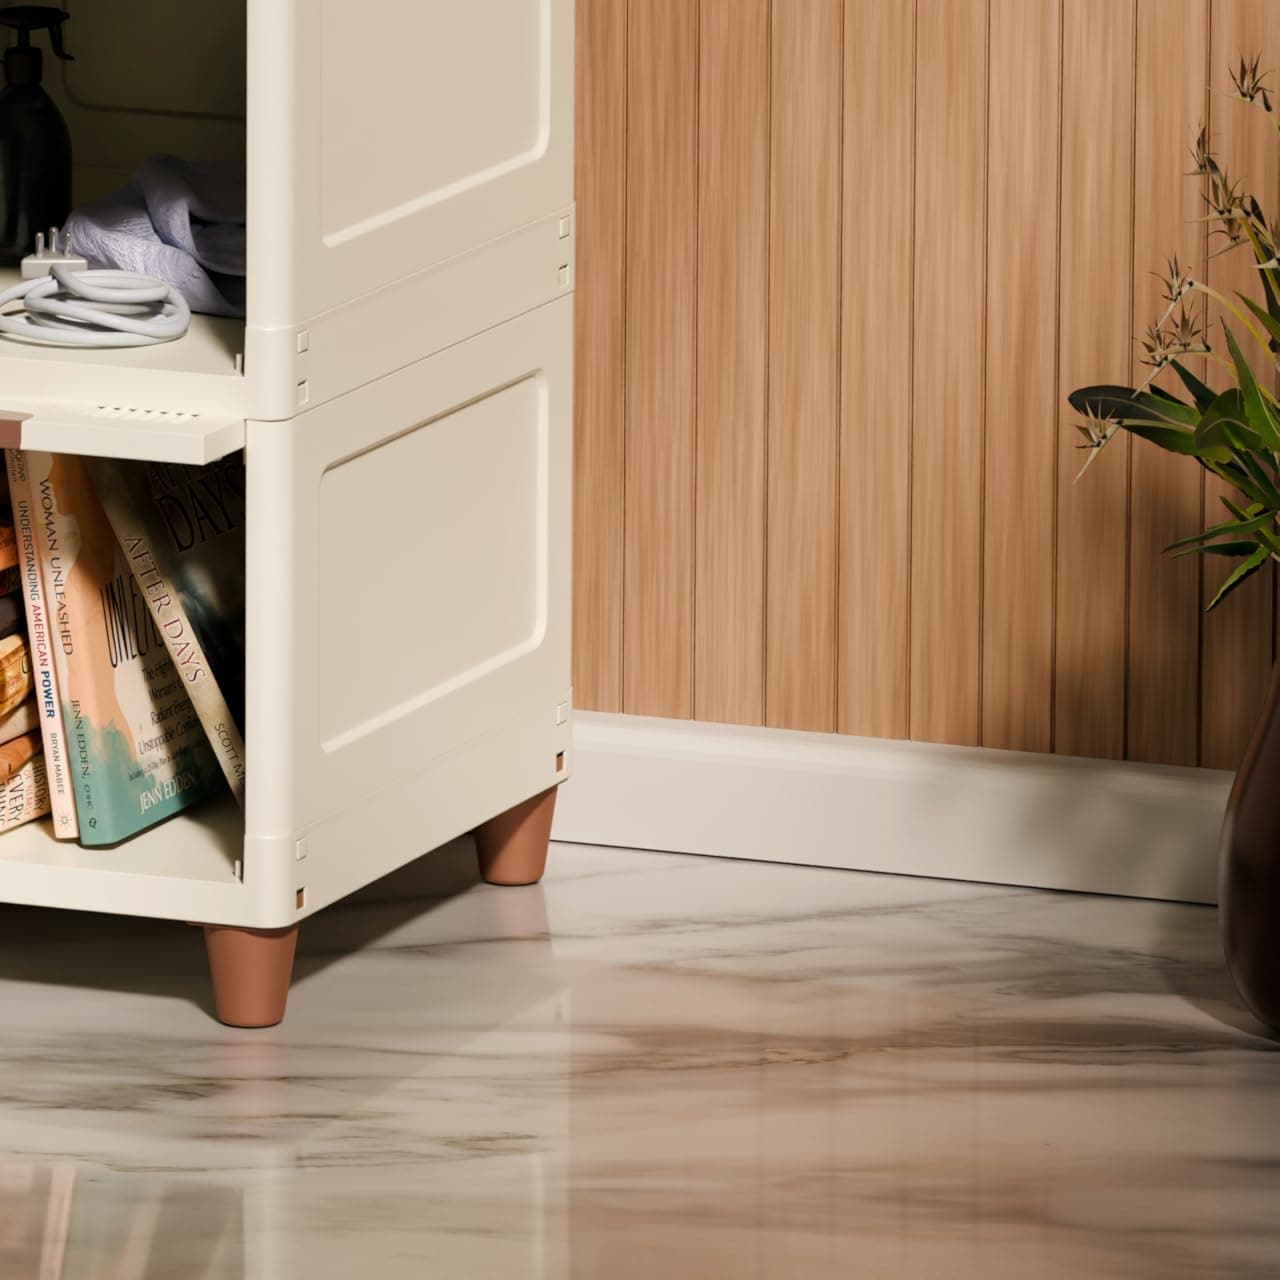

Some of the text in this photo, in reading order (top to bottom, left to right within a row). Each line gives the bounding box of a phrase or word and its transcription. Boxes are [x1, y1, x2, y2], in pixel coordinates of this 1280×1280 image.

[40, 479, 74, 656] WOMAN UNLEASHED
[18, 500, 55, 718] UNDERSTANDING AMERICAN POWER
[124, 536, 206, 683] AFTER DAYS
[72, 700, 83, 730] JENN
[215, 723, 240, 760] SCOTT
[50, 732, 65, 795] BRYAN MABEE
[7, 774, 24, 822] EVERY
[139, 785, 163, 815] JENN
